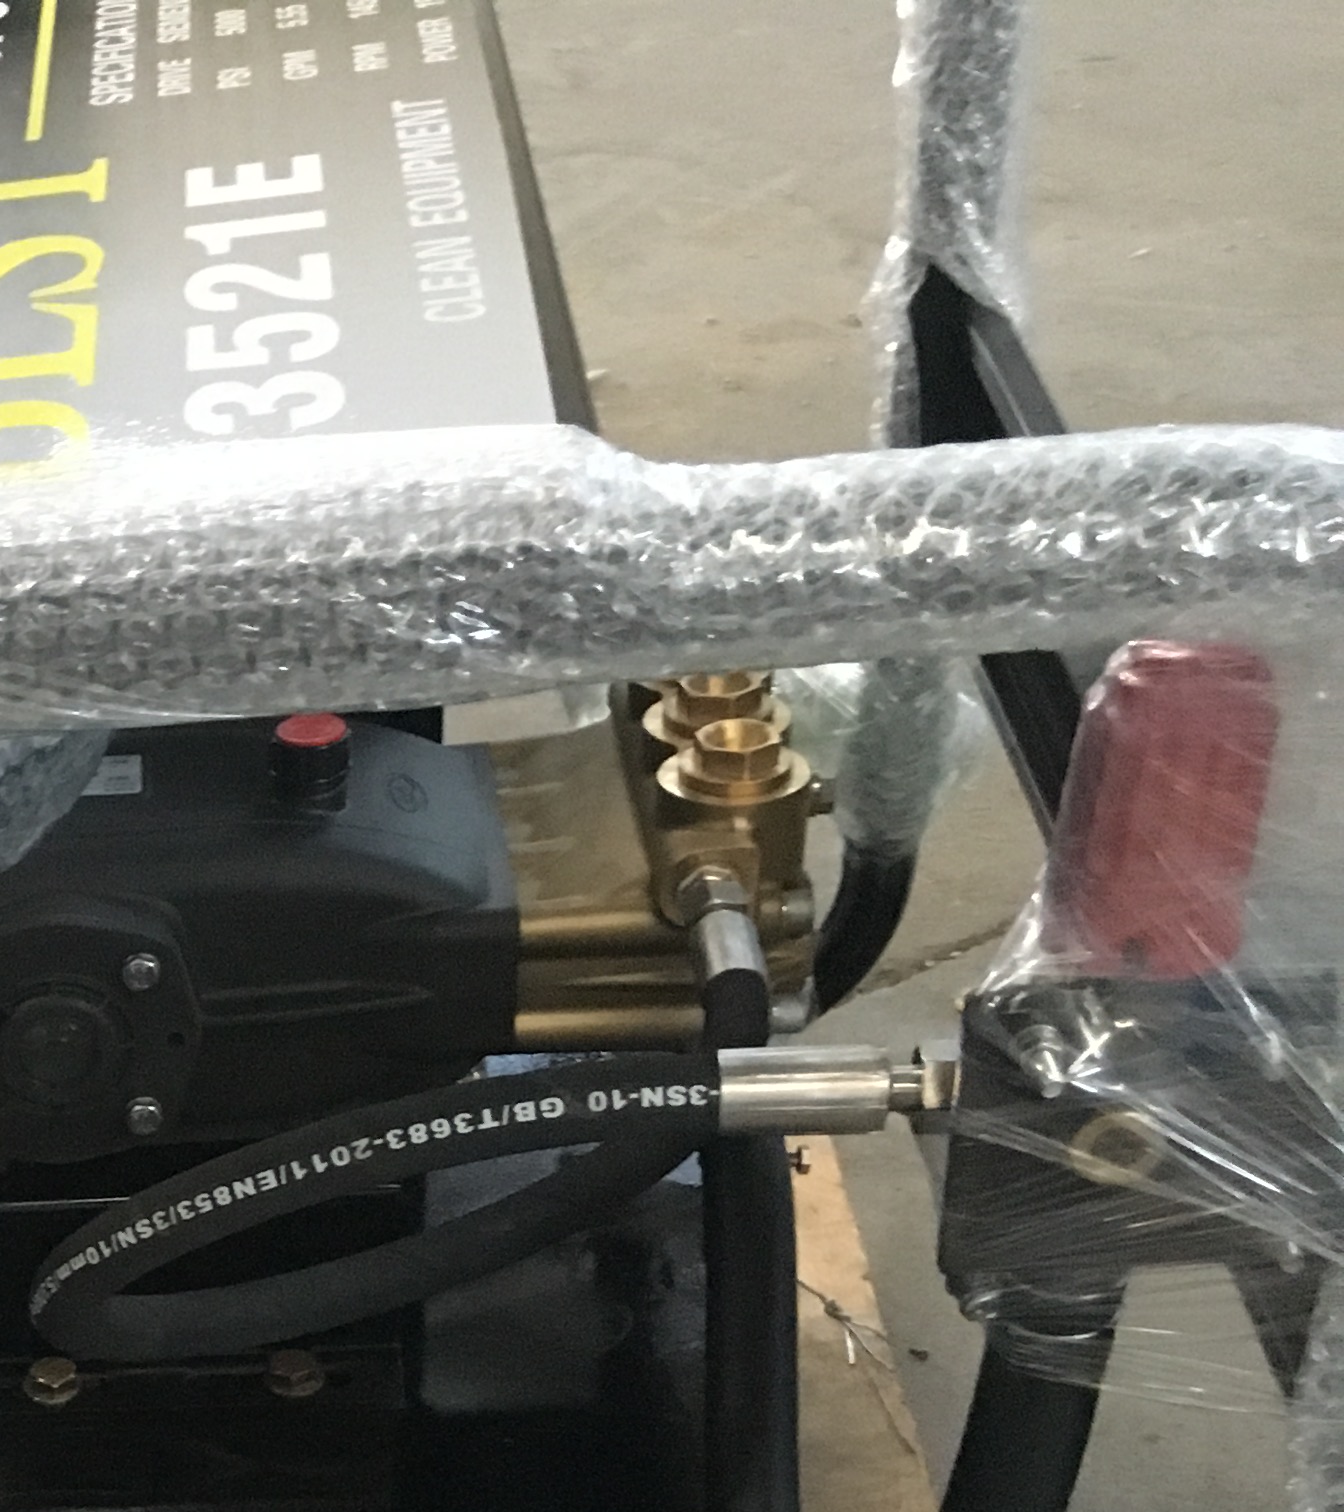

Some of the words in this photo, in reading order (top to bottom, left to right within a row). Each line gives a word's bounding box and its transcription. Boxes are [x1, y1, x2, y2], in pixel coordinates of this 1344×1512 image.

[352, 42, 388, 72] RPM
[417, 17, 458, 63] POWER
[157, 58, 191, 97] DRIVE
[216, 66, 251, 90] PSI
[282, 49, 318, 80] GPM
[391, 99, 468, 228] EQUIPMENT
[184, 153, 346, 436] 3521E
[414, 235, 486, 323] CLEAN
